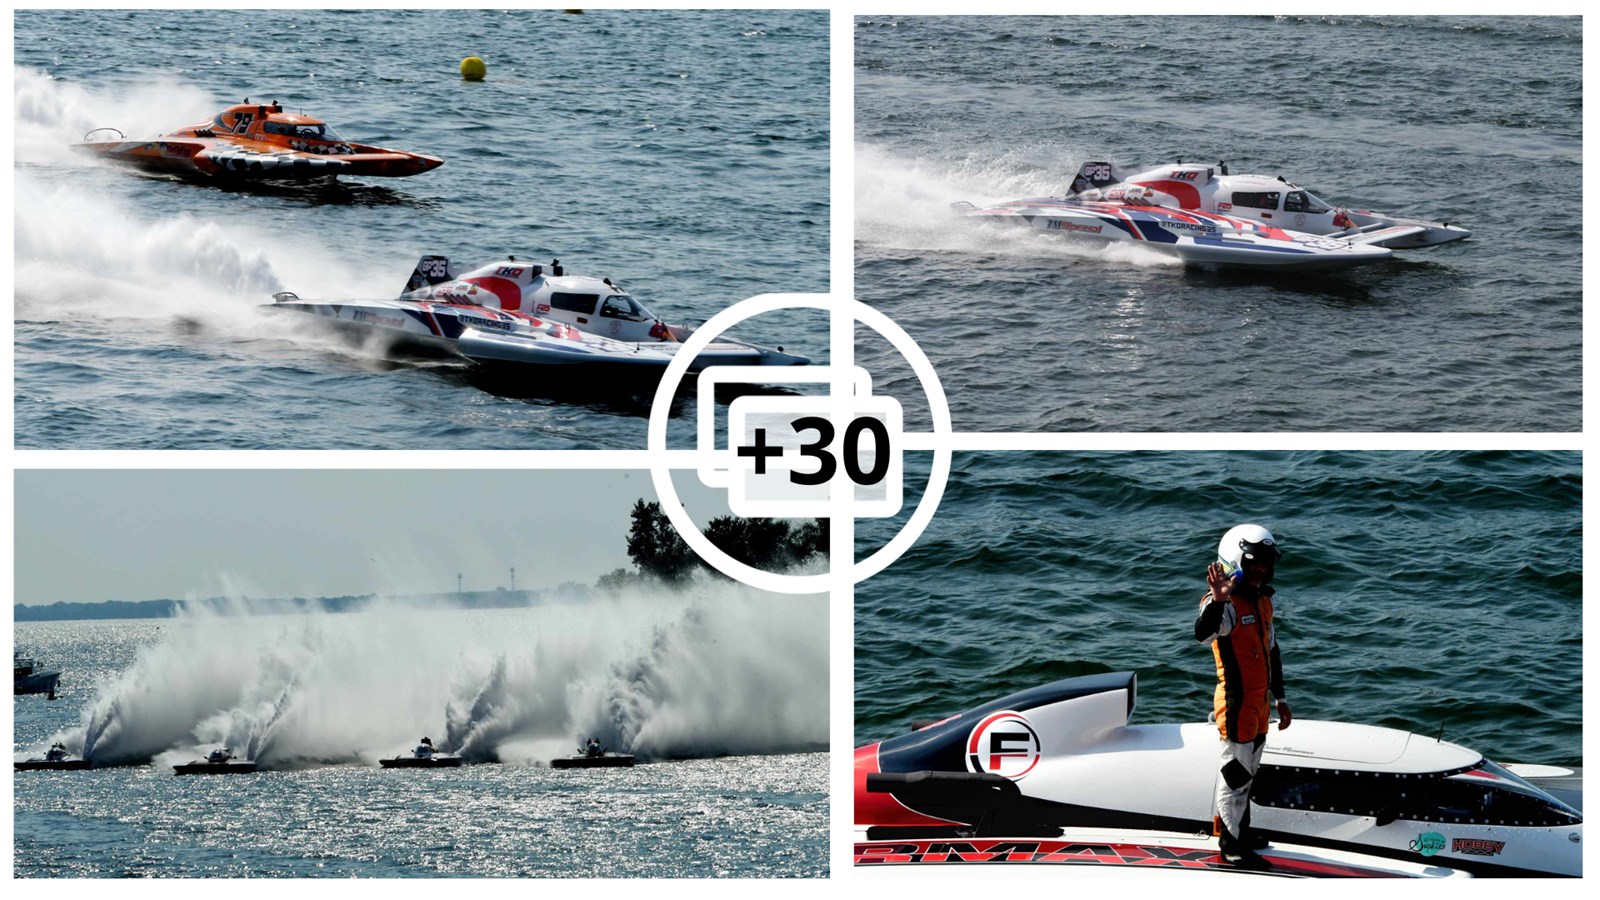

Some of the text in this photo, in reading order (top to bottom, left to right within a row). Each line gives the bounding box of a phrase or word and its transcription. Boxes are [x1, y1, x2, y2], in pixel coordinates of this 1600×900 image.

[232, 112, 255, 134] 79
[1084, 165, 1111, 181] GP35
[1170, 171, 1199, 180] TKO
[422, 260, 447, 278] GP35
[495, 266, 525, 277] TKO
[989, 732, 1030, 770] F
[1452, 838, 1505, 854] HOBBY
